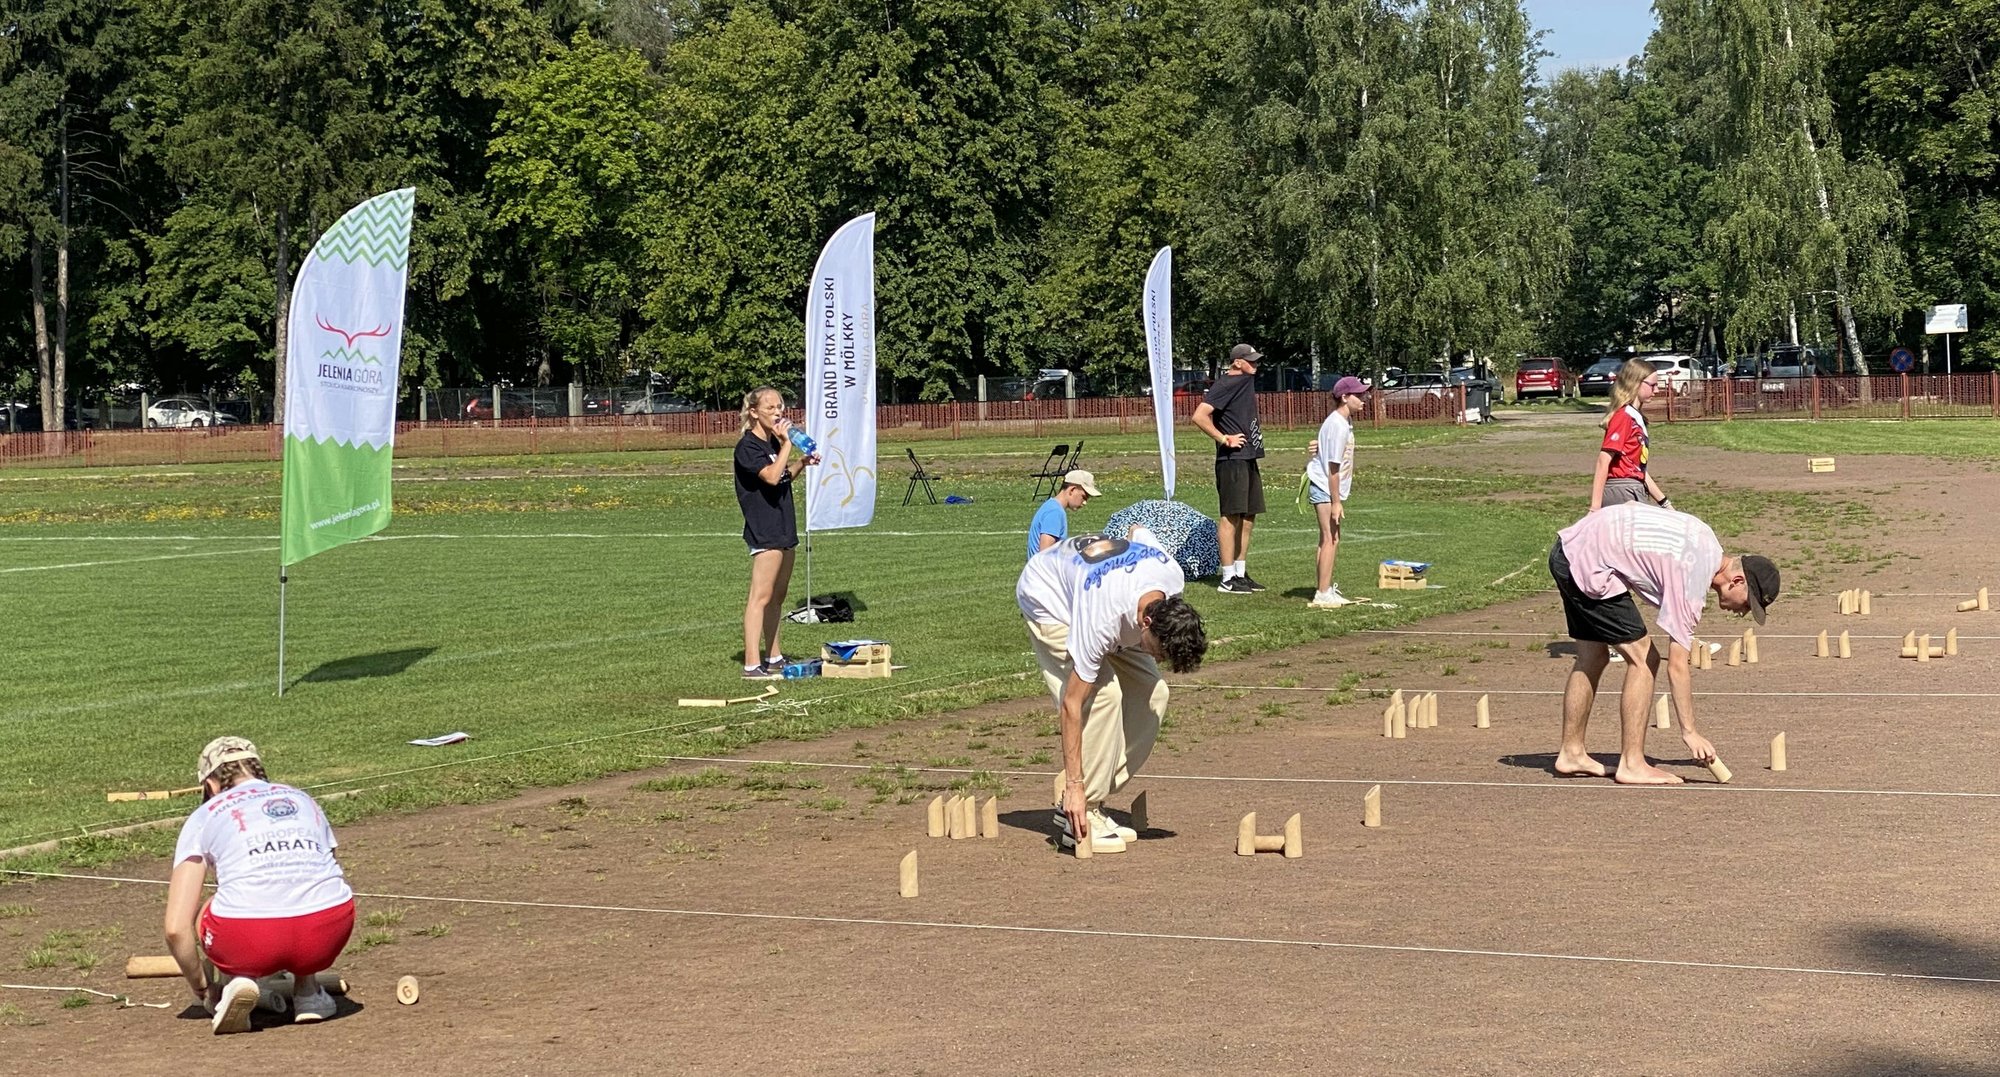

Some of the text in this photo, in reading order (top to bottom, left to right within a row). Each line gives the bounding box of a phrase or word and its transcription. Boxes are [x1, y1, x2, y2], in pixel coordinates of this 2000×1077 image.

[823, 277, 838, 419] GRAND PRIX POLSKI
[840, 312, 857, 388] W MÖLKKY
[317, 363, 383, 385] JELENIA GÓRA
[310, 498, 380, 530] www.jeleniagora.pl
[402, 985, 413, 999] 6
